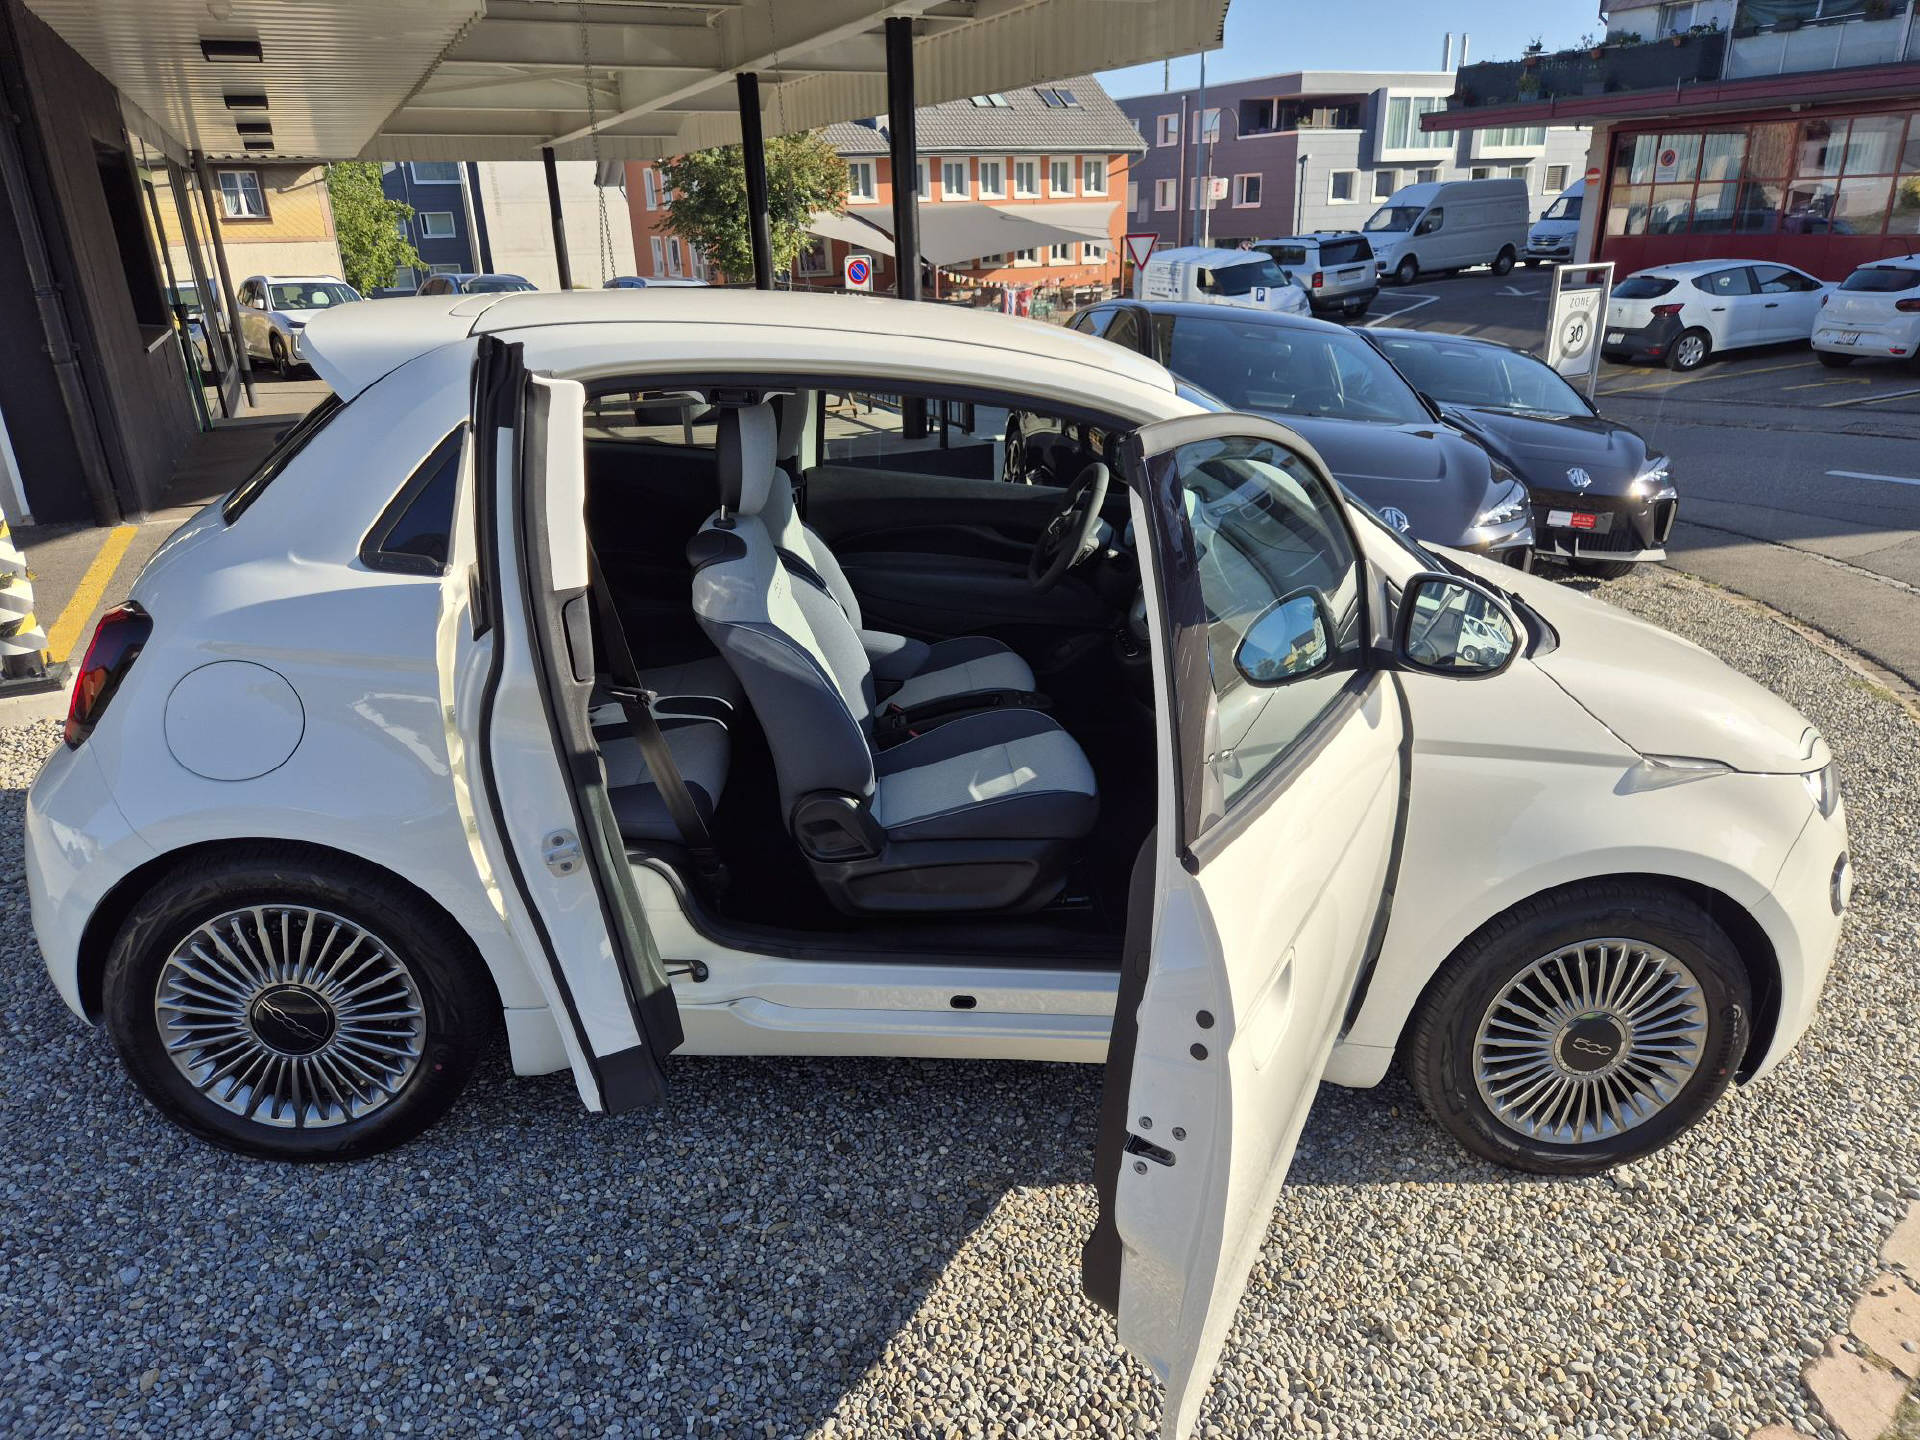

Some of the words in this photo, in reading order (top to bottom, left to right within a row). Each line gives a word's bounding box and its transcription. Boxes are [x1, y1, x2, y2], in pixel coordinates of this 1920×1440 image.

[1570, 296, 1590, 308] ZONE
[1568, 324, 1583, 343] 30
[1568, 468, 1590, 487] MG
[1381, 508, 1407, 531] MG
